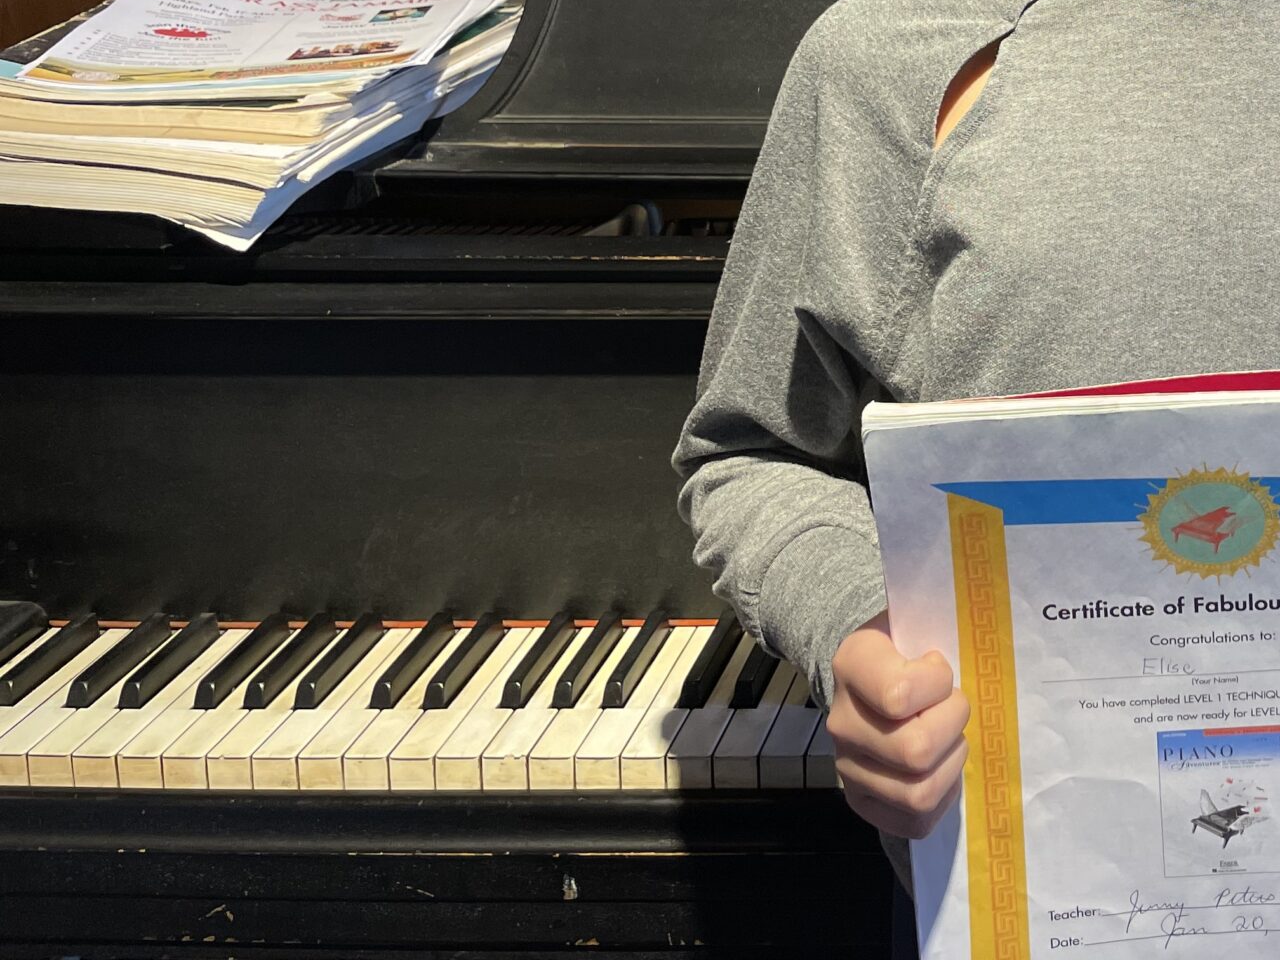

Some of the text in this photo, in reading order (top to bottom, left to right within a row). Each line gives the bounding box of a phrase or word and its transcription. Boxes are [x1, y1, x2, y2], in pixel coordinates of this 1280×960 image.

[1042, 600, 1155, 621] Certificate
[1163, 596, 1185, 615] of
[1150, 631, 1277, 648] Congratulations to:
[1142, 657, 1196, 675] Elise
[1192, 675, 1239, 686] (Your Name)
[1079, 700, 1099, 709] You
[1102, 698, 1126, 708] have
[1129, 693, 1180, 707] completed
[1183, 695, 1213, 704] LEVEL
[1217, 693, 1222, 702] 1
[1133, 713, 1153, 724] and
[1156, 714, 1174, 722] are
[1177, 713, 1198, 721] now
[1201, 708, 1230, 721] ready
[1233, 708, 1248, 718] for
[1250, 707, 1280, 717] LEVEL
[1163, 744, 1234, 762] PIANO
[1048, 906, 1101, 921] Teacher:
[1161, 912, 1208, 950] Jan
[1232, 915, 1268, 936] 20,
[1050, 936, 1084, 949] Date:
